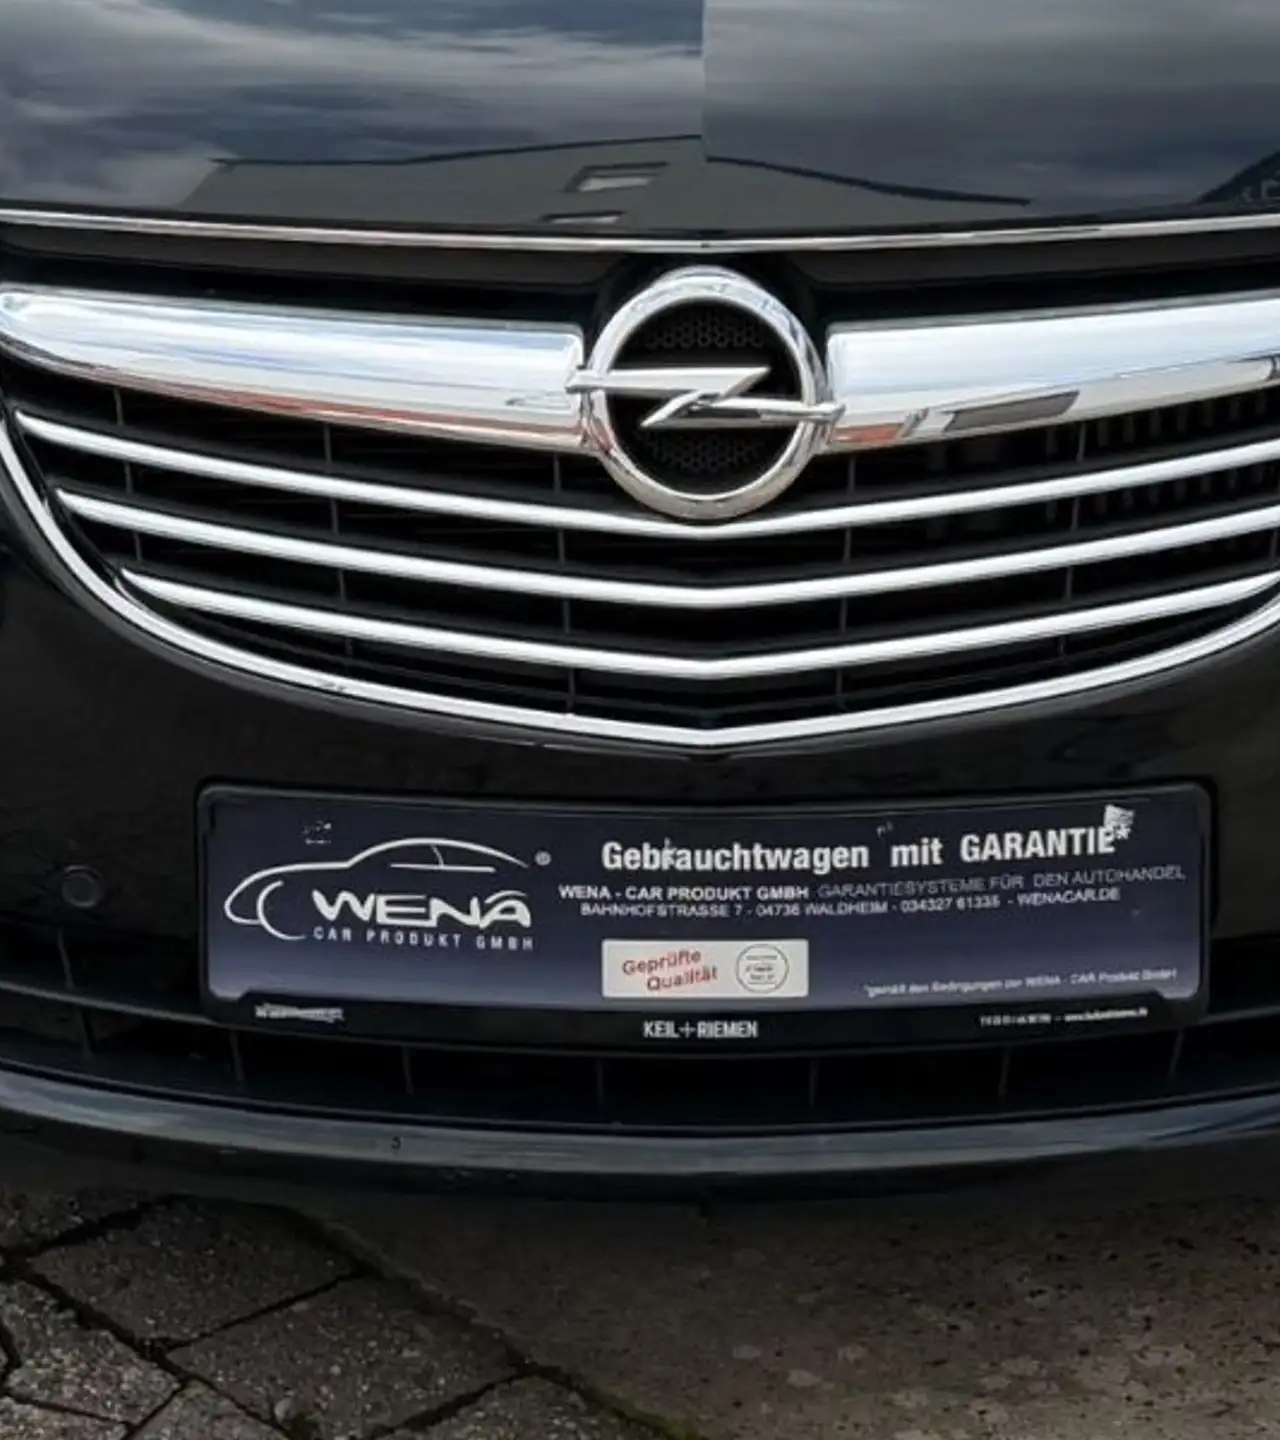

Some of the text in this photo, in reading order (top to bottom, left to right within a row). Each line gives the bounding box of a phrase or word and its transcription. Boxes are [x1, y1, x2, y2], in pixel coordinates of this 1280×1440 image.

[601, 840, 869, 876] Gebrauchtwagen
[890, 836, 943, 867] mit
[558, 885, 612, 900] WENA
[625, 886, 663, 901] CAR
[667, 886, 751, 901] PRODUKT
[756, 885, 809, 901] GMBH
[1032, 871, 1068, 888] DEN
[1072, 864, 1186, 885] AUTOHANDEL
[313, 926, 534, 950] CAR PRODUKT GMBH
[622, 948, 702, 975] Geprüfte
[646, 965, 719, 991] Qualität
